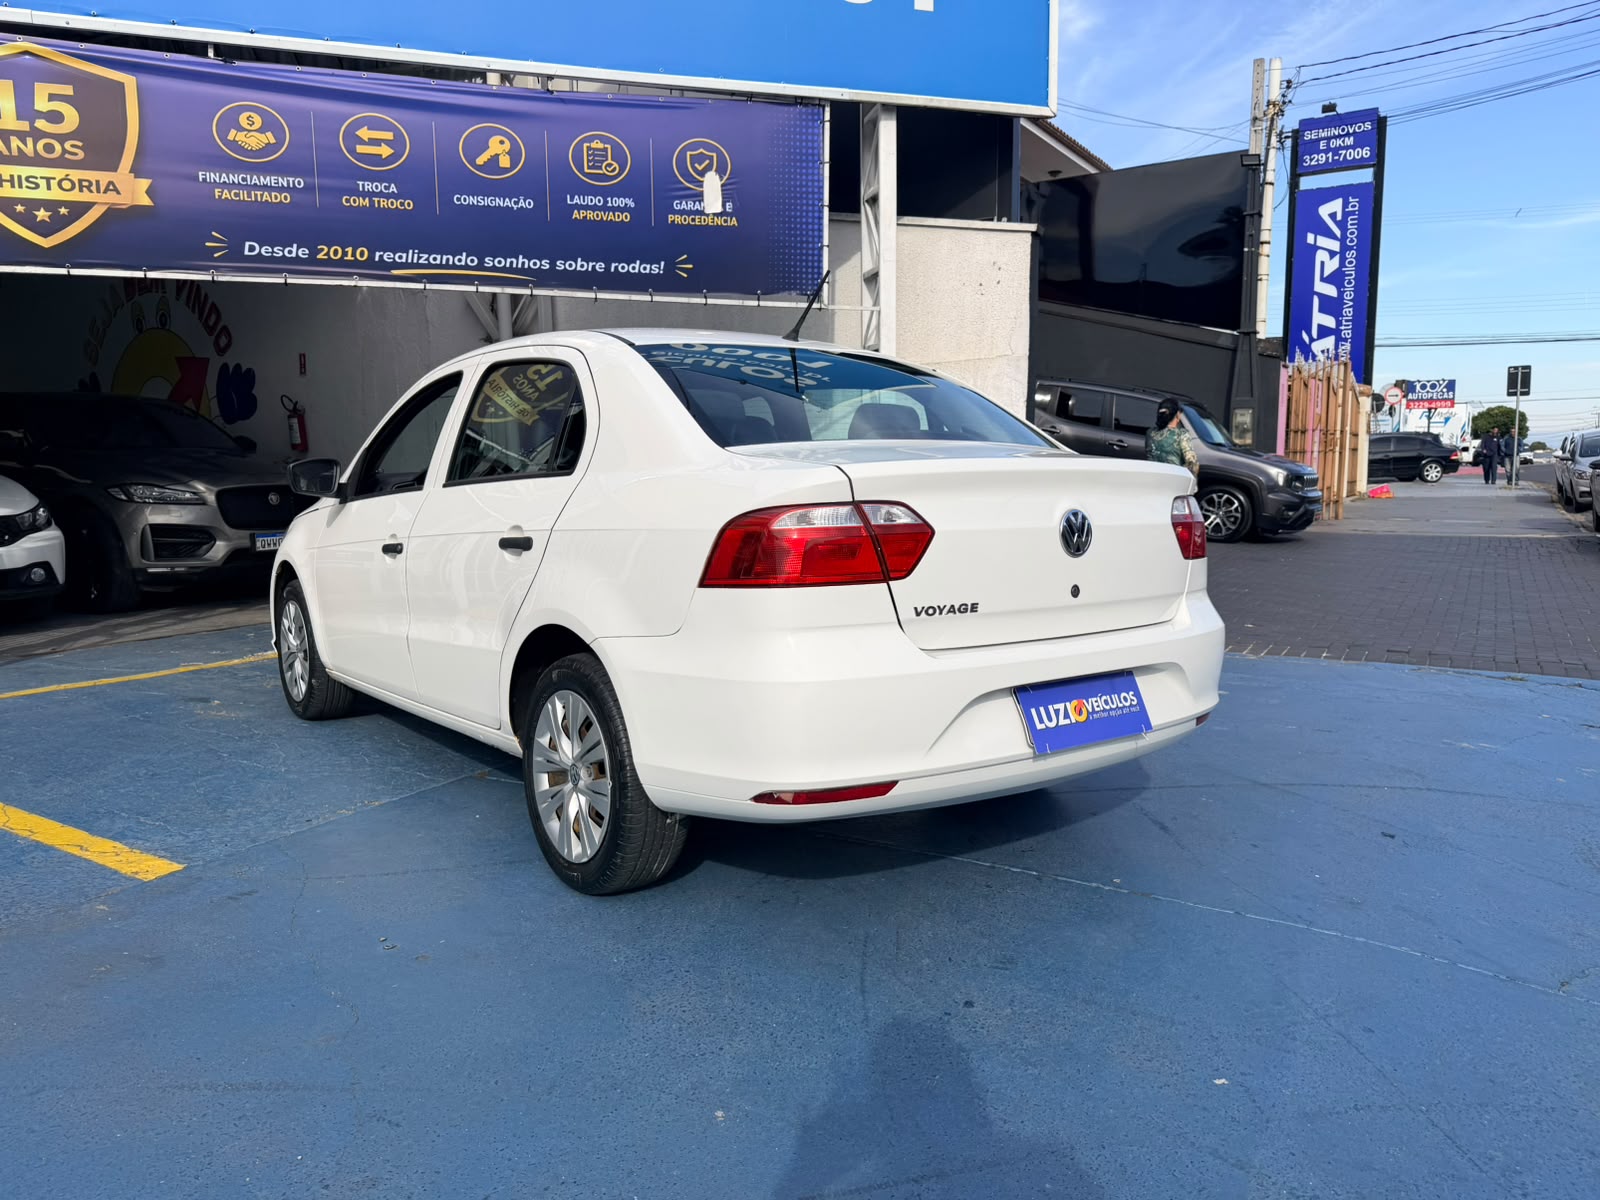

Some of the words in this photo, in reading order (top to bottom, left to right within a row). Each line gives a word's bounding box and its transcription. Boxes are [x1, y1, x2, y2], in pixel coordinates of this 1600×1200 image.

[0, 79, 80, 134] 15
[1304, 122, 1372, 140] SEMINOVOS
[1320, 140, 1327, 150] E
[1303, 147, 1371, 166] 3291-7006
[0, 174, 122, 195] HISTÓRIA
[198, 171, 305, 188] FINANCIAMENTO
[357, 181, 398, 194] TROCA
[214, 188, 291, 204] FACILITADO
[342, 196, 370, 208] COM
[373, 197, 414, 210] TROCO
[453, 194, 534, 211] CONSIGNAÇÃO
[566, 194, 604, 206] LAUDO
[606, 197, 635, 208] 100%
[726, 202, 733, 212] E
[572, 209, 631, 222] APROVADO
[668, 213, 738, 226] PROCEDÊNCIA
[244, 241, 310, 258] Desde
[316, 245, 369, 261] 2010
[374, 249, 478, 267] realizando
[483, 255, 550, 269] sonhos
[556, 258, 605, 272] sobre
[610, 260, 665, 274] rodas!
[1413, 380, 1449, 392] 100%
[914, 602, 979, 617] VOYAGE
[1031, 699, 1088, 730] LUZIO
[1083, 691, 1138, 713] VEÍCULOS
